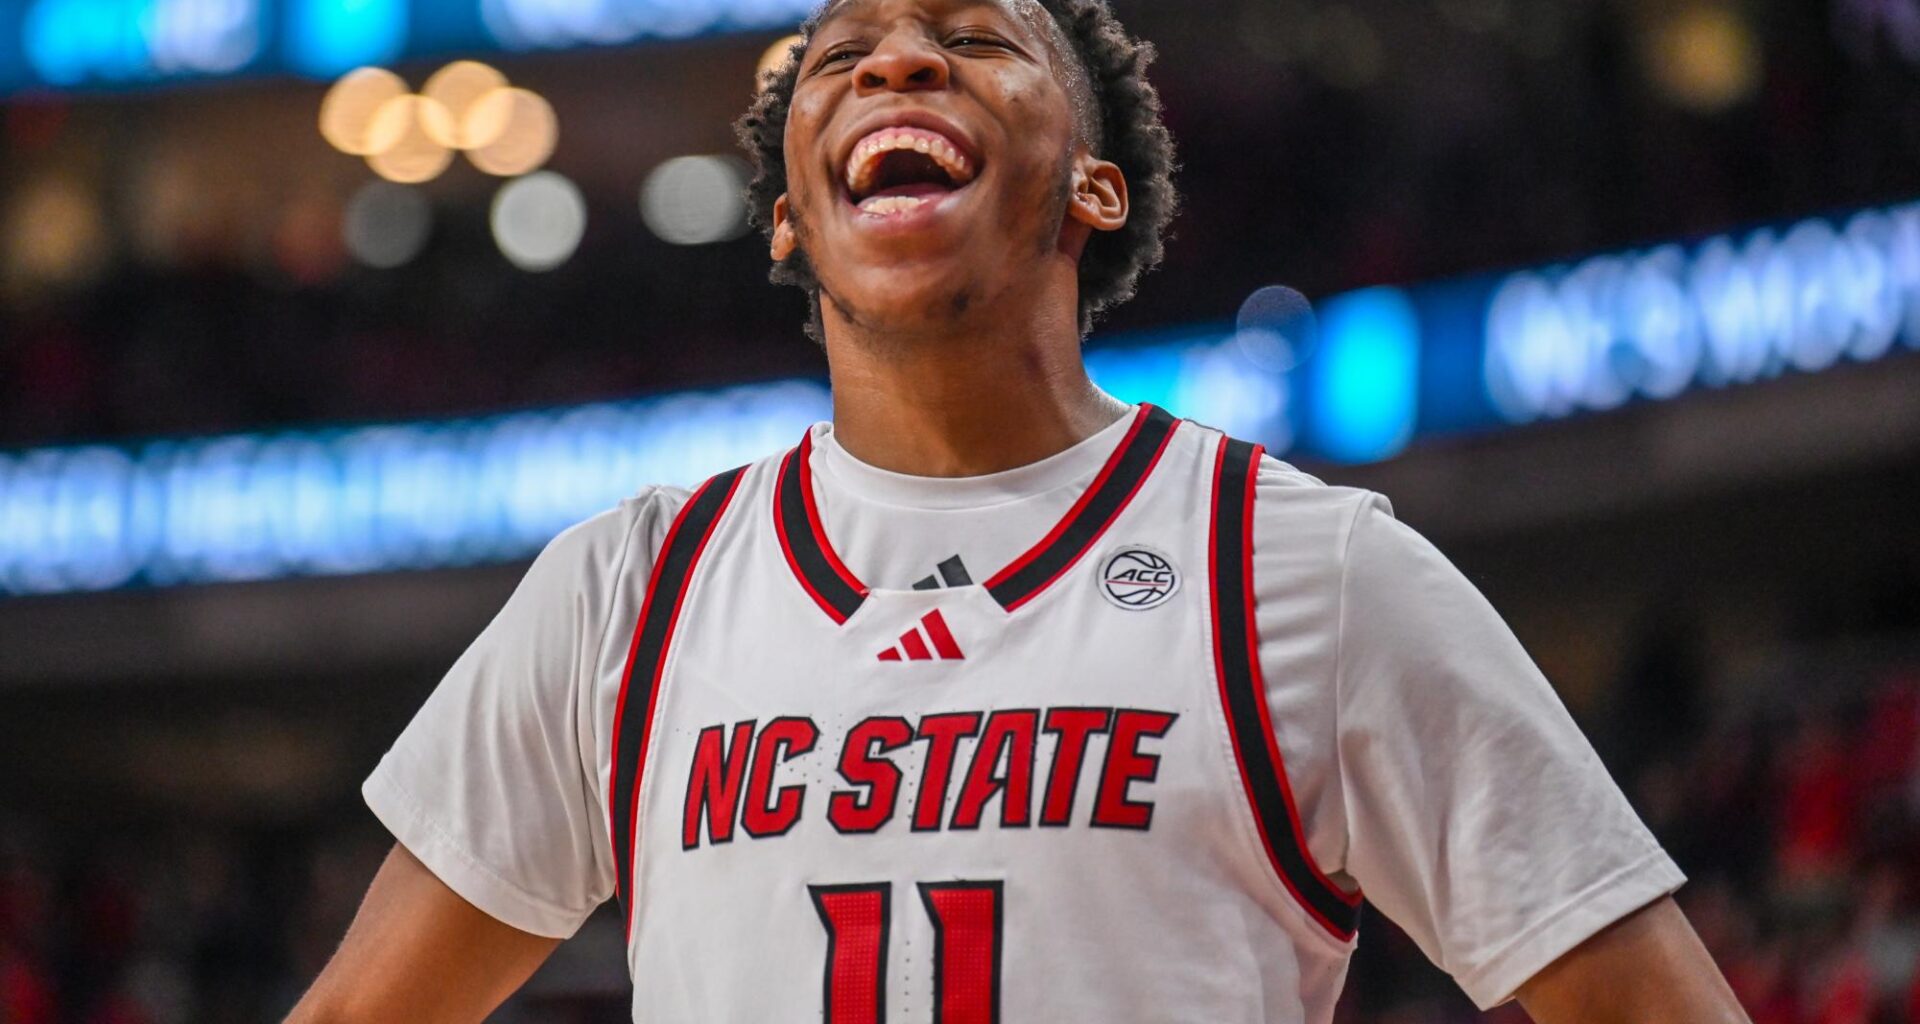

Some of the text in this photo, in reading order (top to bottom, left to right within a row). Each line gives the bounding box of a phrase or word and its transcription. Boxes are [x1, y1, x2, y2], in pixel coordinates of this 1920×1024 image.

[1112, 568, 1172, 583] ACC
[682, 706, 1180, 851] NC STATE
[807, 880, 1004, 1024] 11
